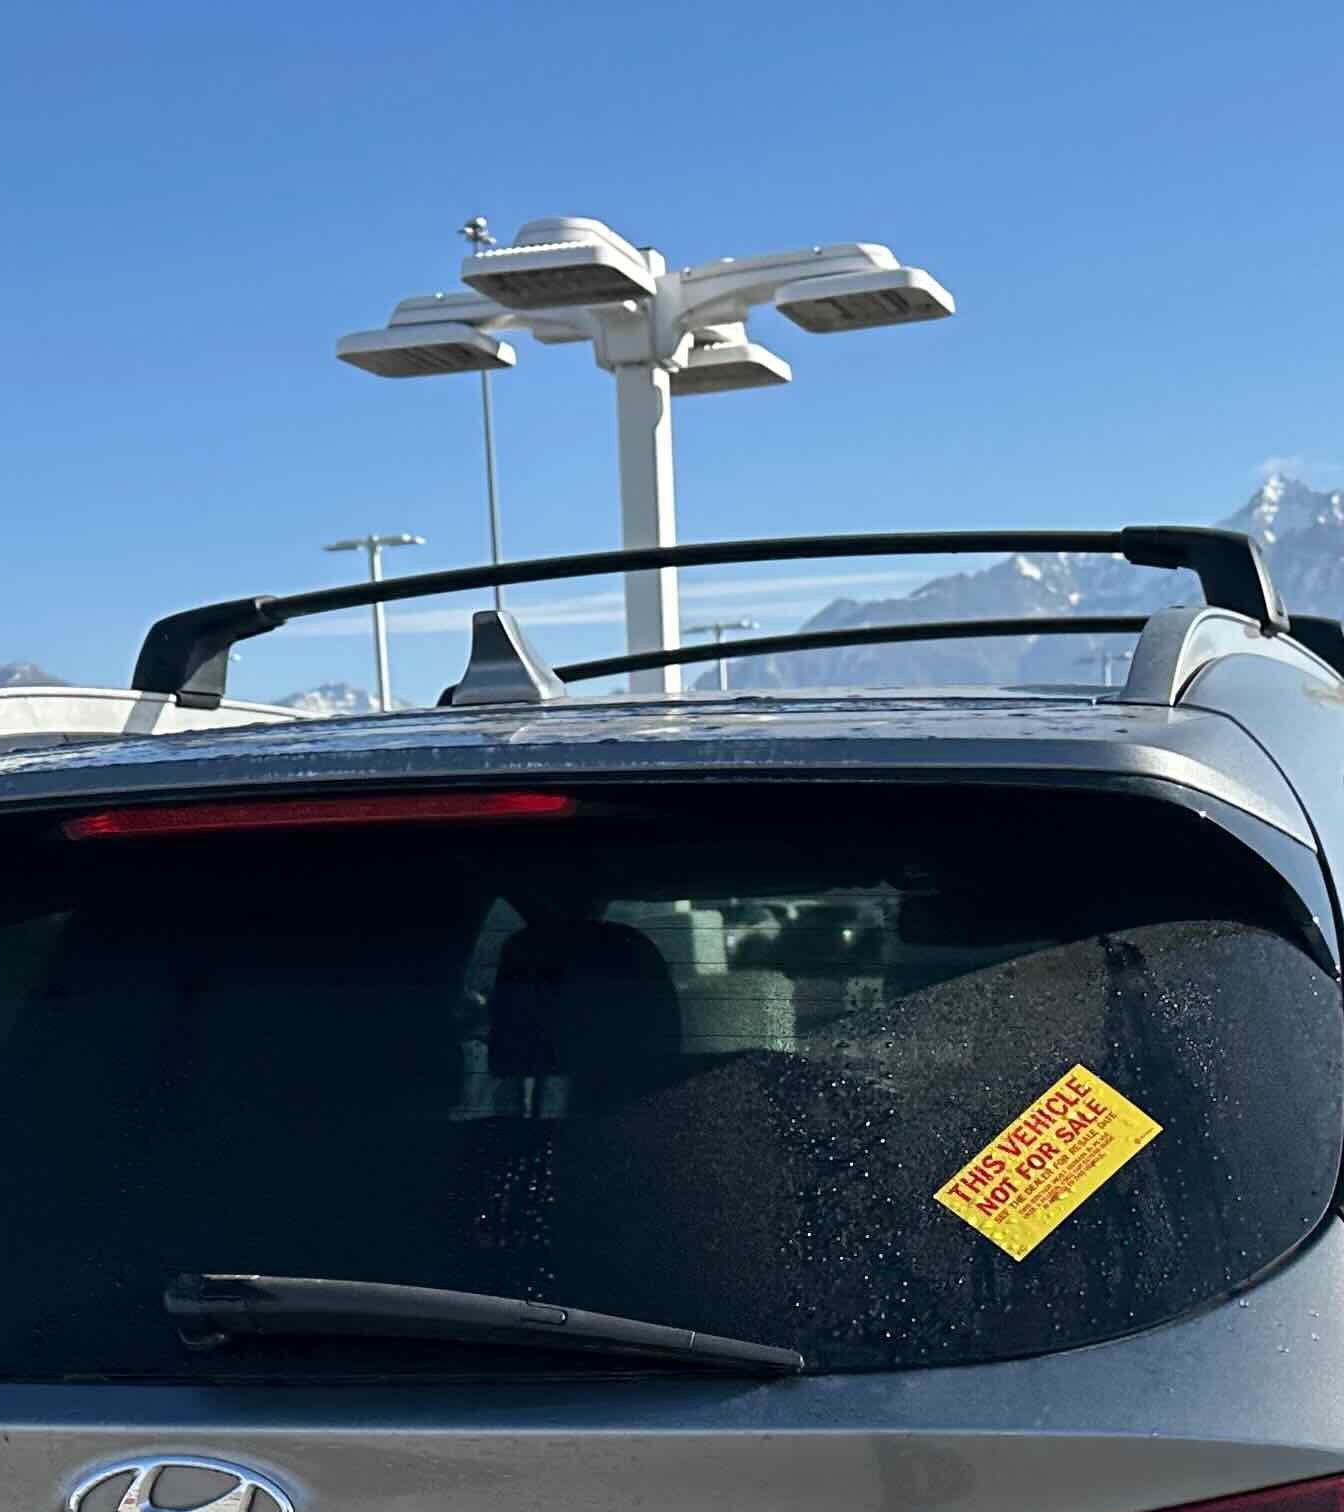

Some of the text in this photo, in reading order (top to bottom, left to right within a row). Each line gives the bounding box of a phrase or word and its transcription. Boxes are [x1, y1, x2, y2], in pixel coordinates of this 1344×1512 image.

[947, 1153, 1007, 1203] THIS
[997, 1076, 1091, 1158] VEHICLE
[975, 1177, 1019, 1216] NOT
[1014, 1141, 1058, 1180] FOR
[1055, 1098, 1108, 1144] SALE
